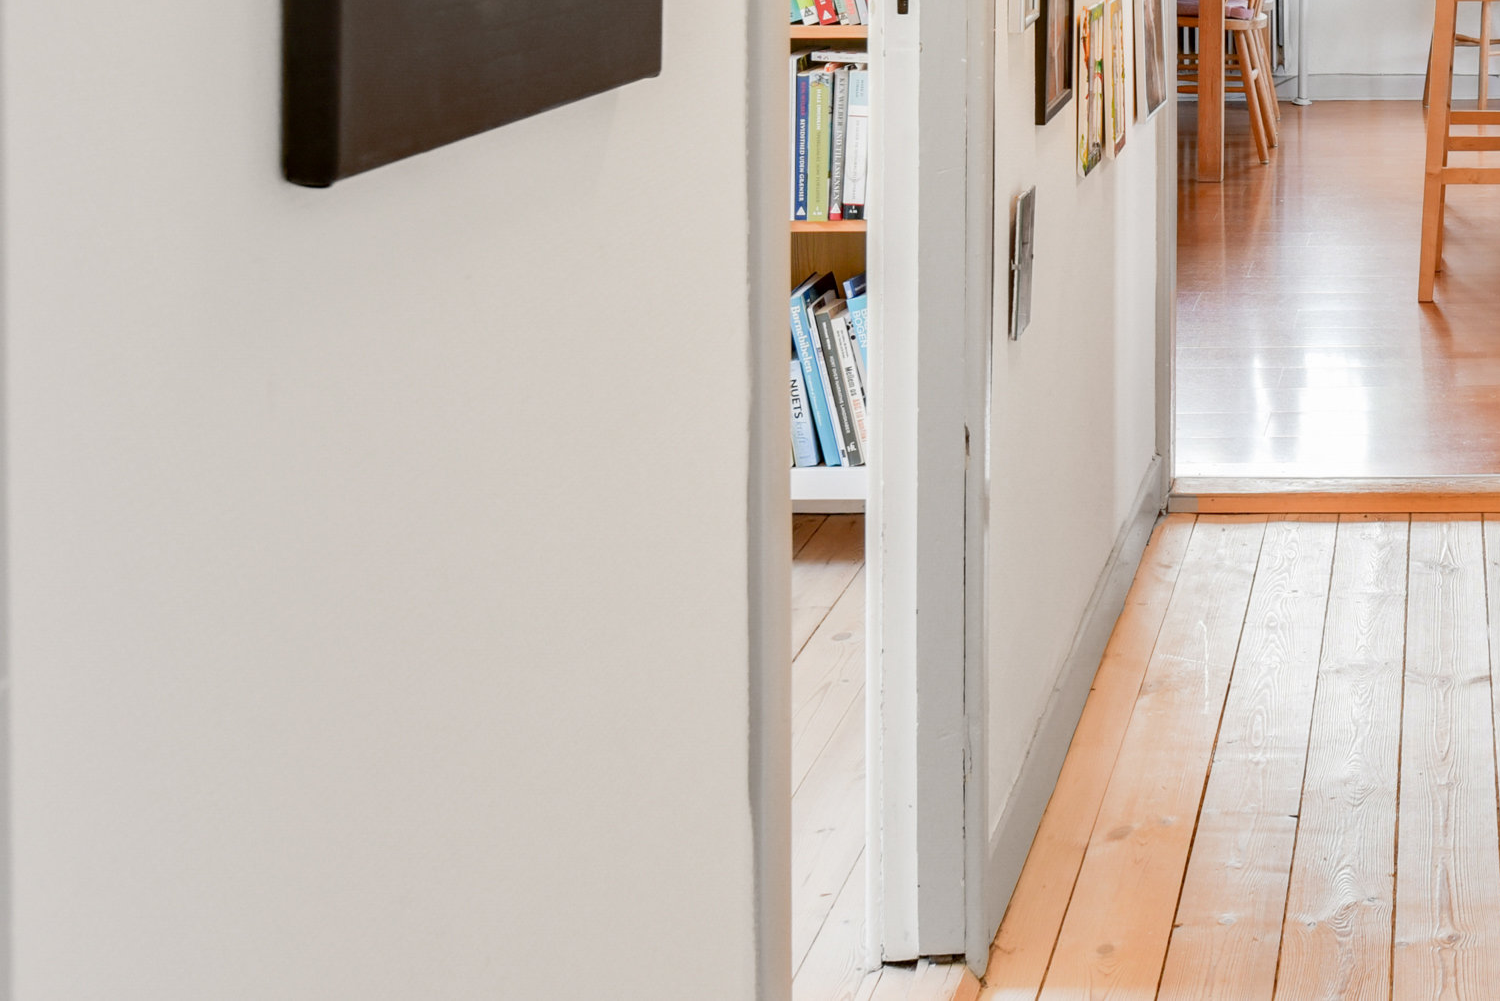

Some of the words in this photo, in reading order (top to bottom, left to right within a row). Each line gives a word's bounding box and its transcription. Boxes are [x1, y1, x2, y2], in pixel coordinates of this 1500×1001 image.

[832, 162, 841, 200] ESSENSEN
[791, 305, 814, 373] Børnebibelen
[852, 310, 867, 348] BOGEN
[844, 365, 856, 387] Mellem
[849, 388, 857, 396] os
[789, 378, 803, 419] NUETS
